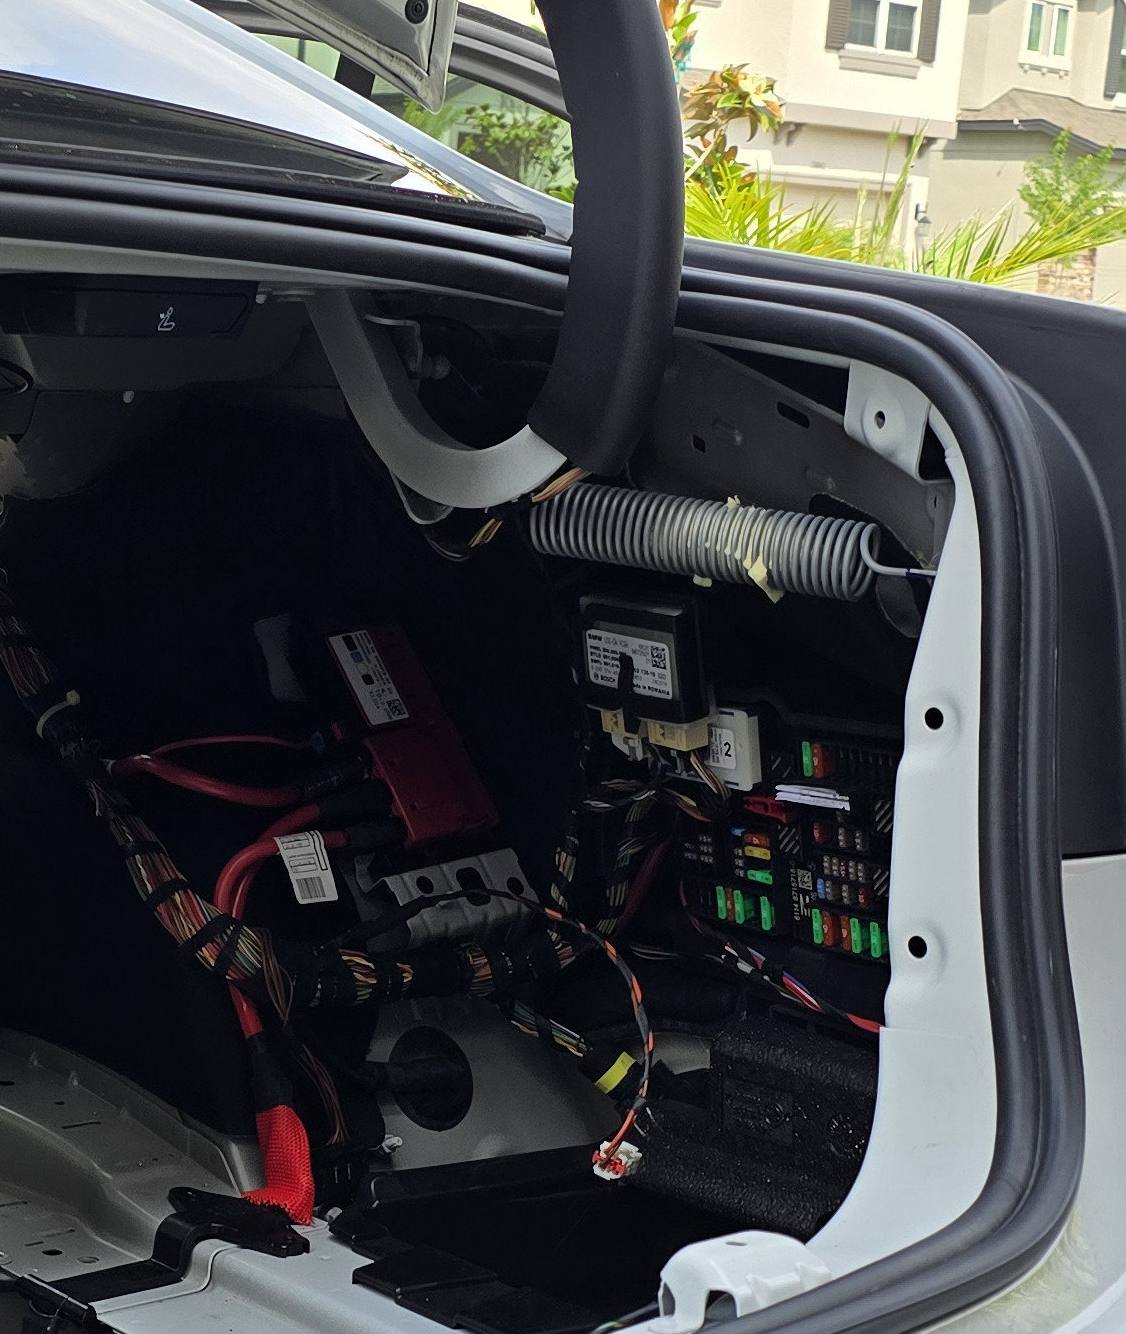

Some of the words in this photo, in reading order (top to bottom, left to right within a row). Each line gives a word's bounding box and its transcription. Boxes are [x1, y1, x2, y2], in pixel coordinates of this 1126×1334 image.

[600, 674, 616, 683] BOSCH
[647, 685, 670, 696] ROMANIA
[723, 741, 732, 757] 2
